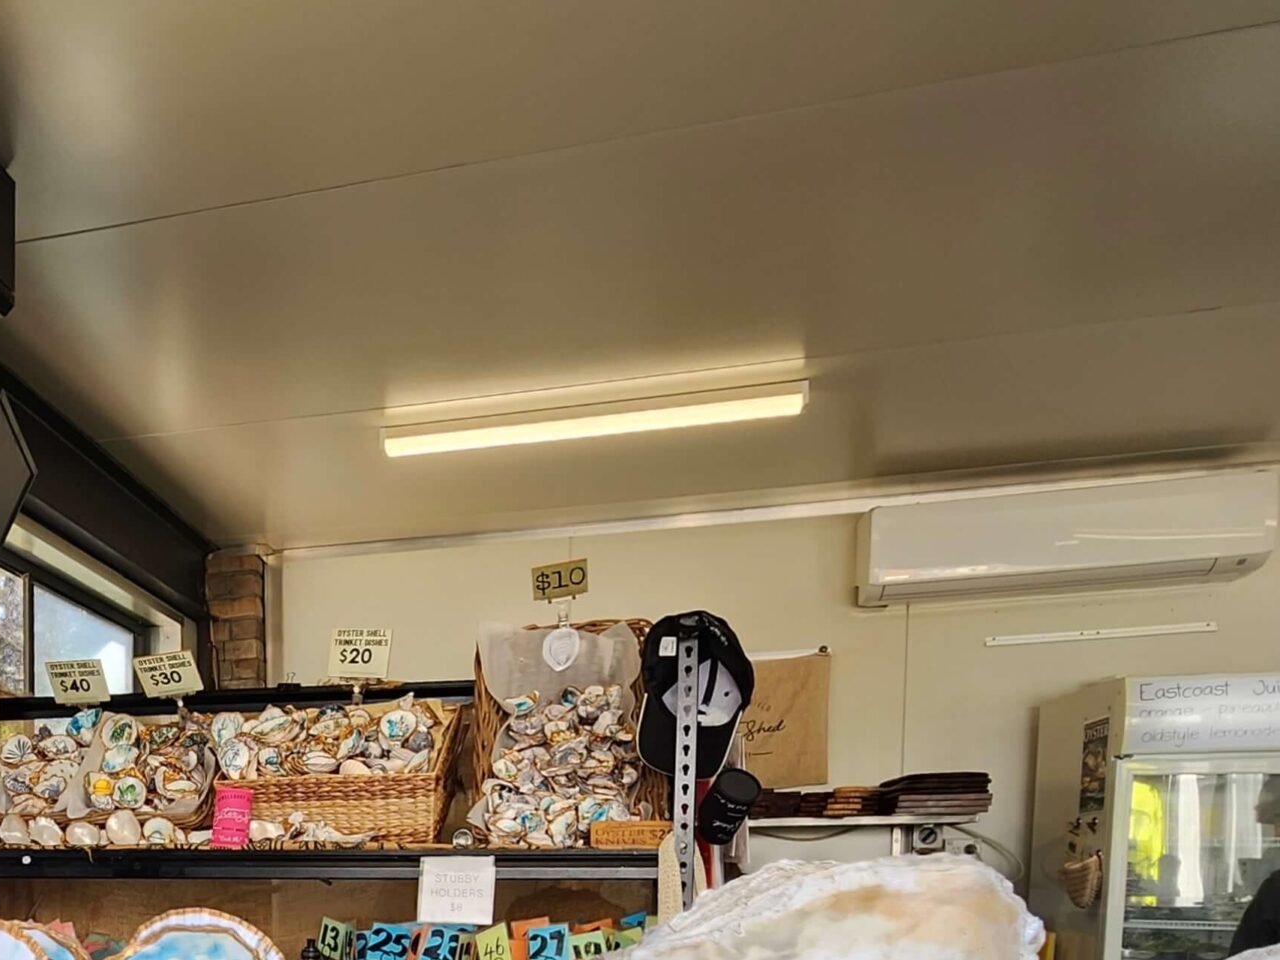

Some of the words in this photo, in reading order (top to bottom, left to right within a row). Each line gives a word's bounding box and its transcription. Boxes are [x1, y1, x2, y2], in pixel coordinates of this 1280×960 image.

[536, 566, 586, 595] $10
[339, 648, 372, 664] $20
[59, 678, 91, 693] $40
[150, 670, 182, 686] $30
[1139, 680, 1231, 701] Eastcoast
[649, 828, 674, 841] $2
[434, 873, 479, 884] STUBBY
[430, 888, 484, 898] HOLDERS
[320, 923, 341, 952] 13
[367, 927, 411, 958] 25
[530, 929, 566, 960] 27
[484, 935, 505, 960] 46
